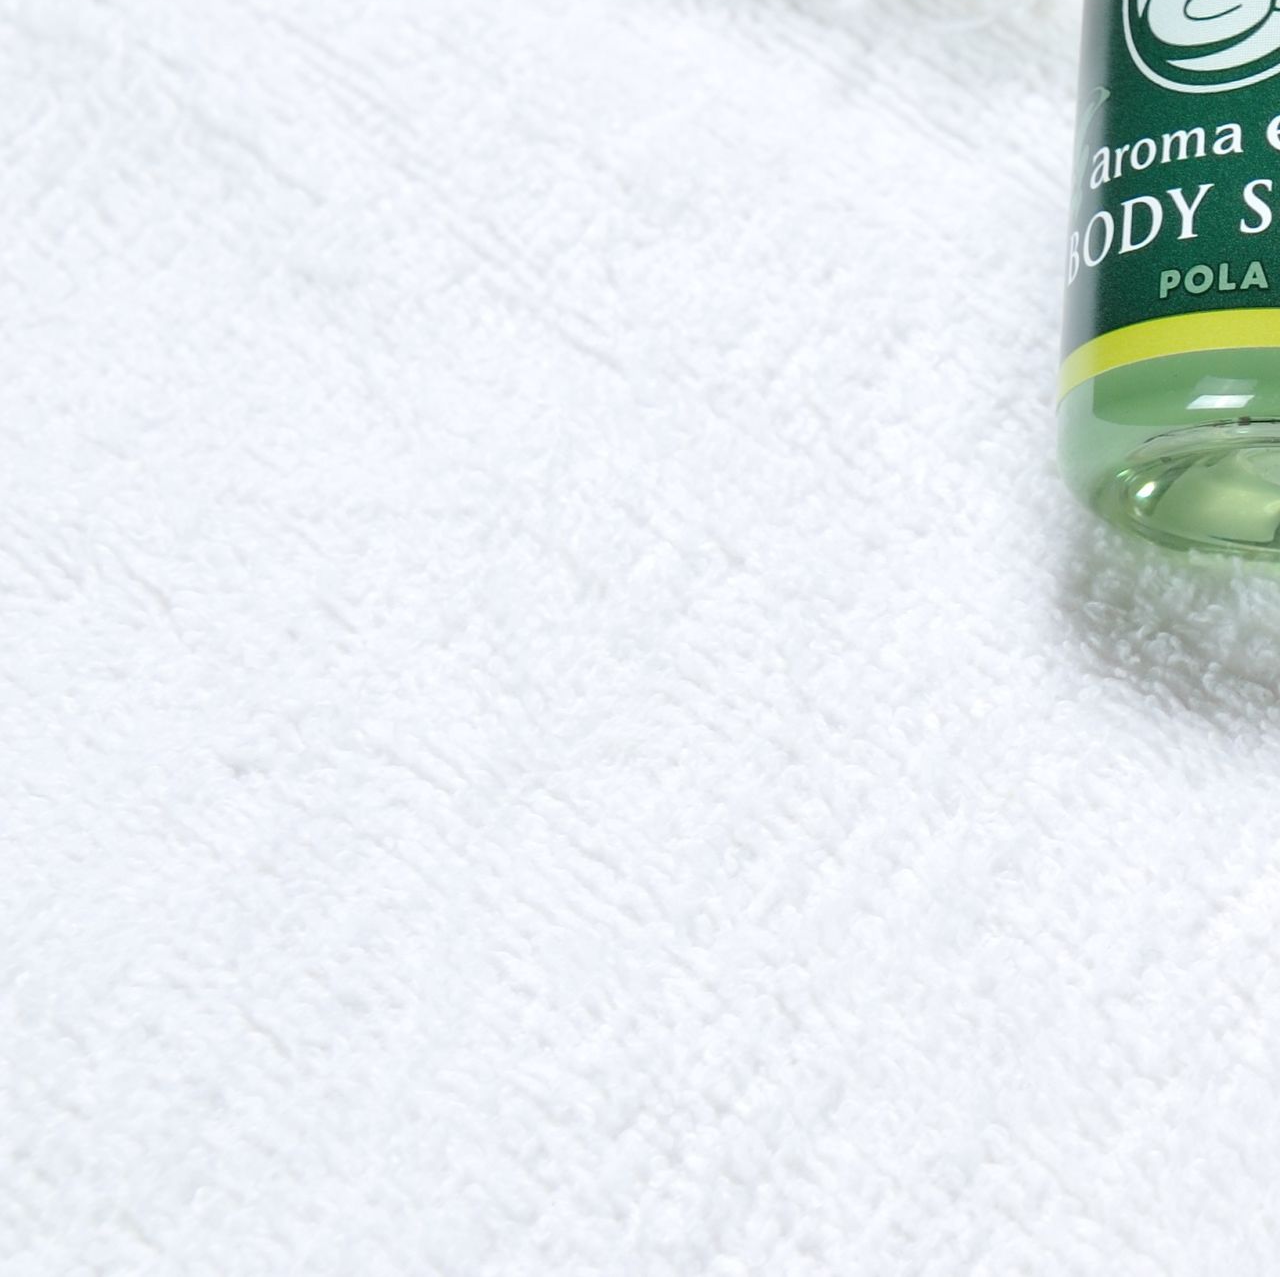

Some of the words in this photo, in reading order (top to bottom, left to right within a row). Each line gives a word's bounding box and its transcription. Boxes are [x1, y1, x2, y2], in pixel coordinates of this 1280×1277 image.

[1088, 122, 1244, 190] aroma
[1068, 183, 1215, 285] BODY
[1158, 260, 1270, 299] POLA
